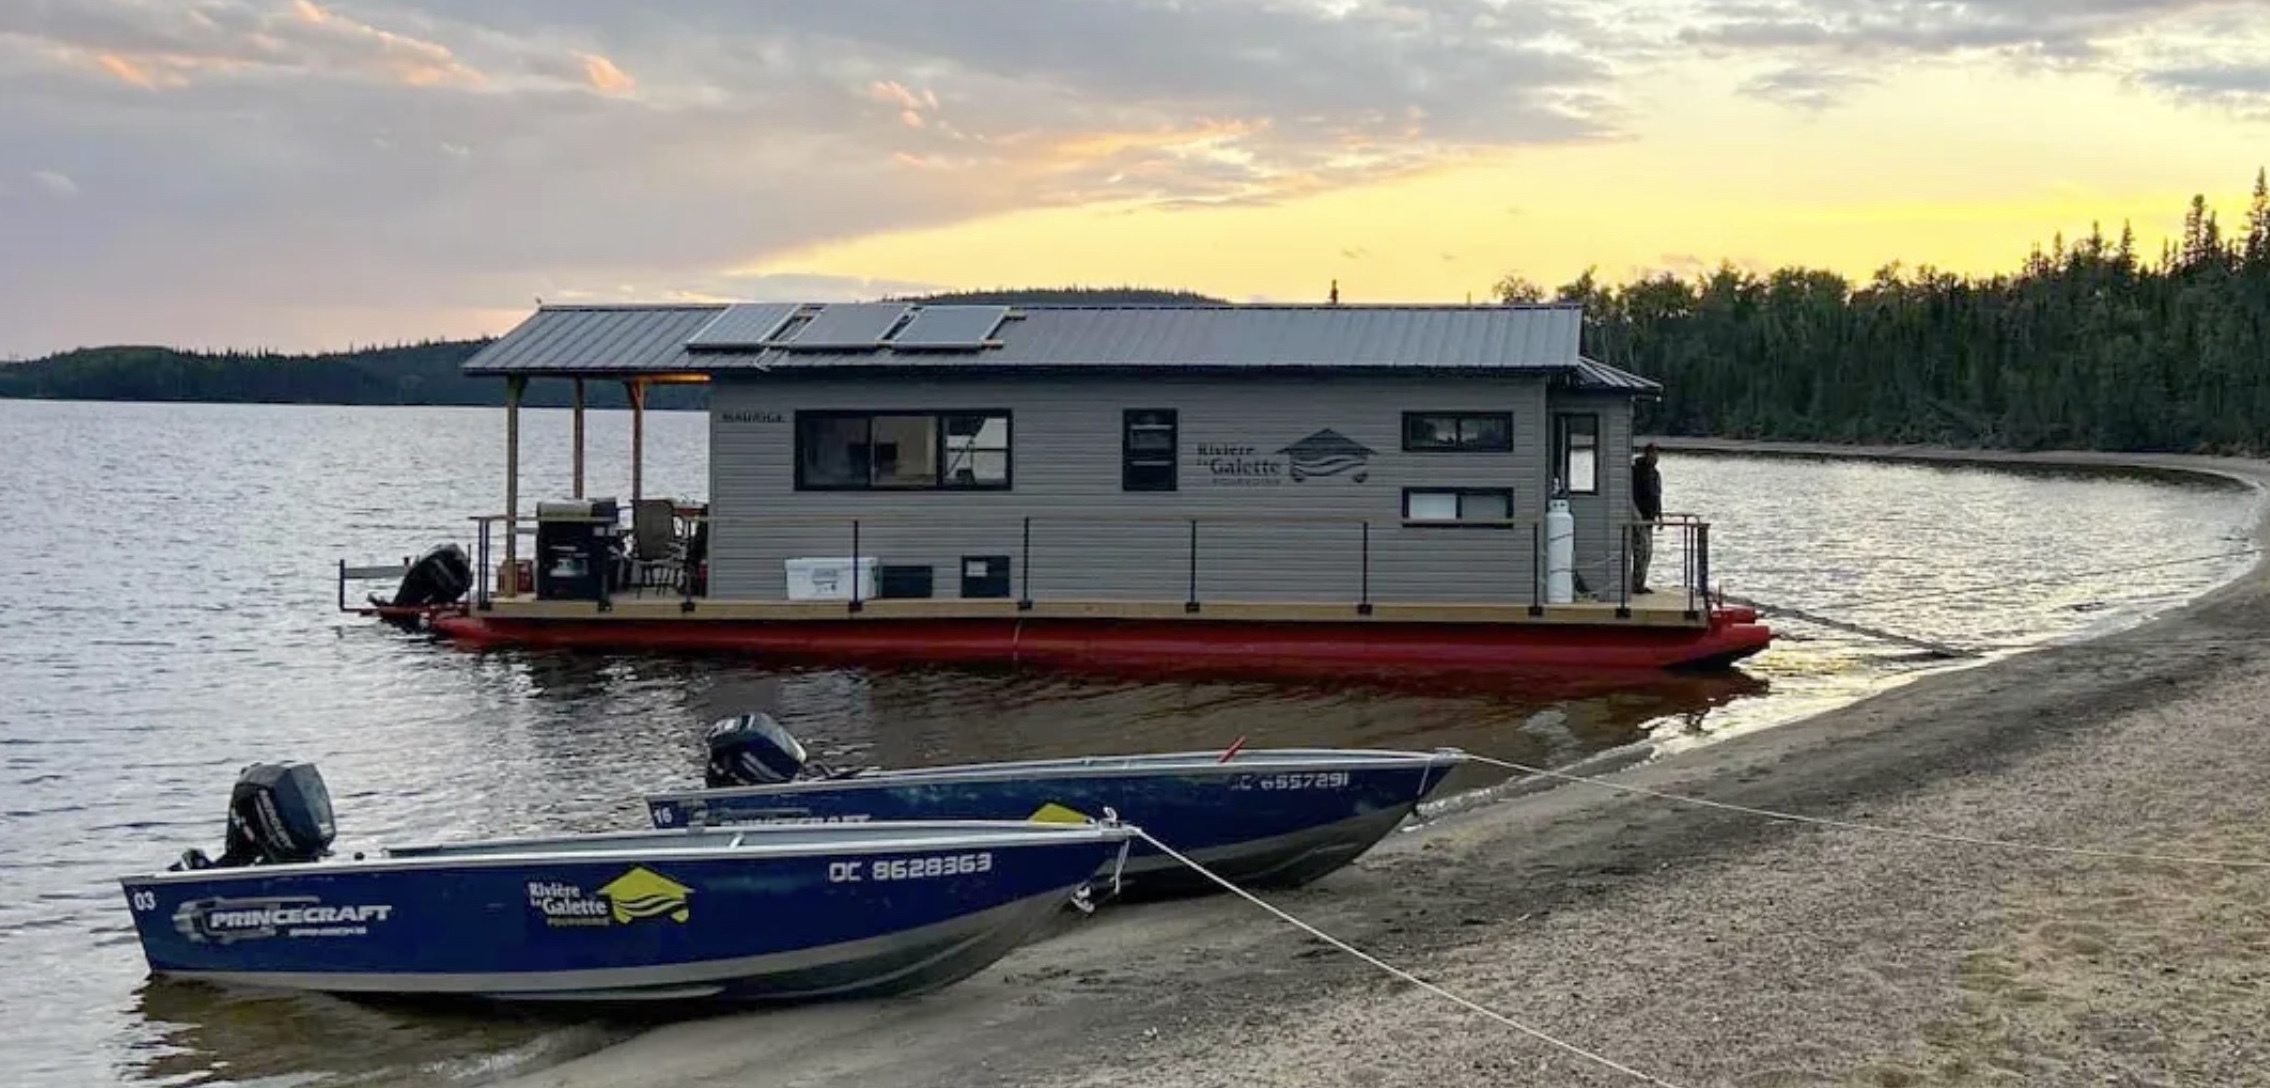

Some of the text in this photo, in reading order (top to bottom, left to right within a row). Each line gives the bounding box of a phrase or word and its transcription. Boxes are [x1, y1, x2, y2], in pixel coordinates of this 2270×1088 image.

[653, 807, 673, 824] 16
[872, 852, 993, 881] 8628363
[134, 891, 156, 911] 03
[542, 897, 608, 915] Galette
[211, 905, 392, 928] PRINCECRAFT
